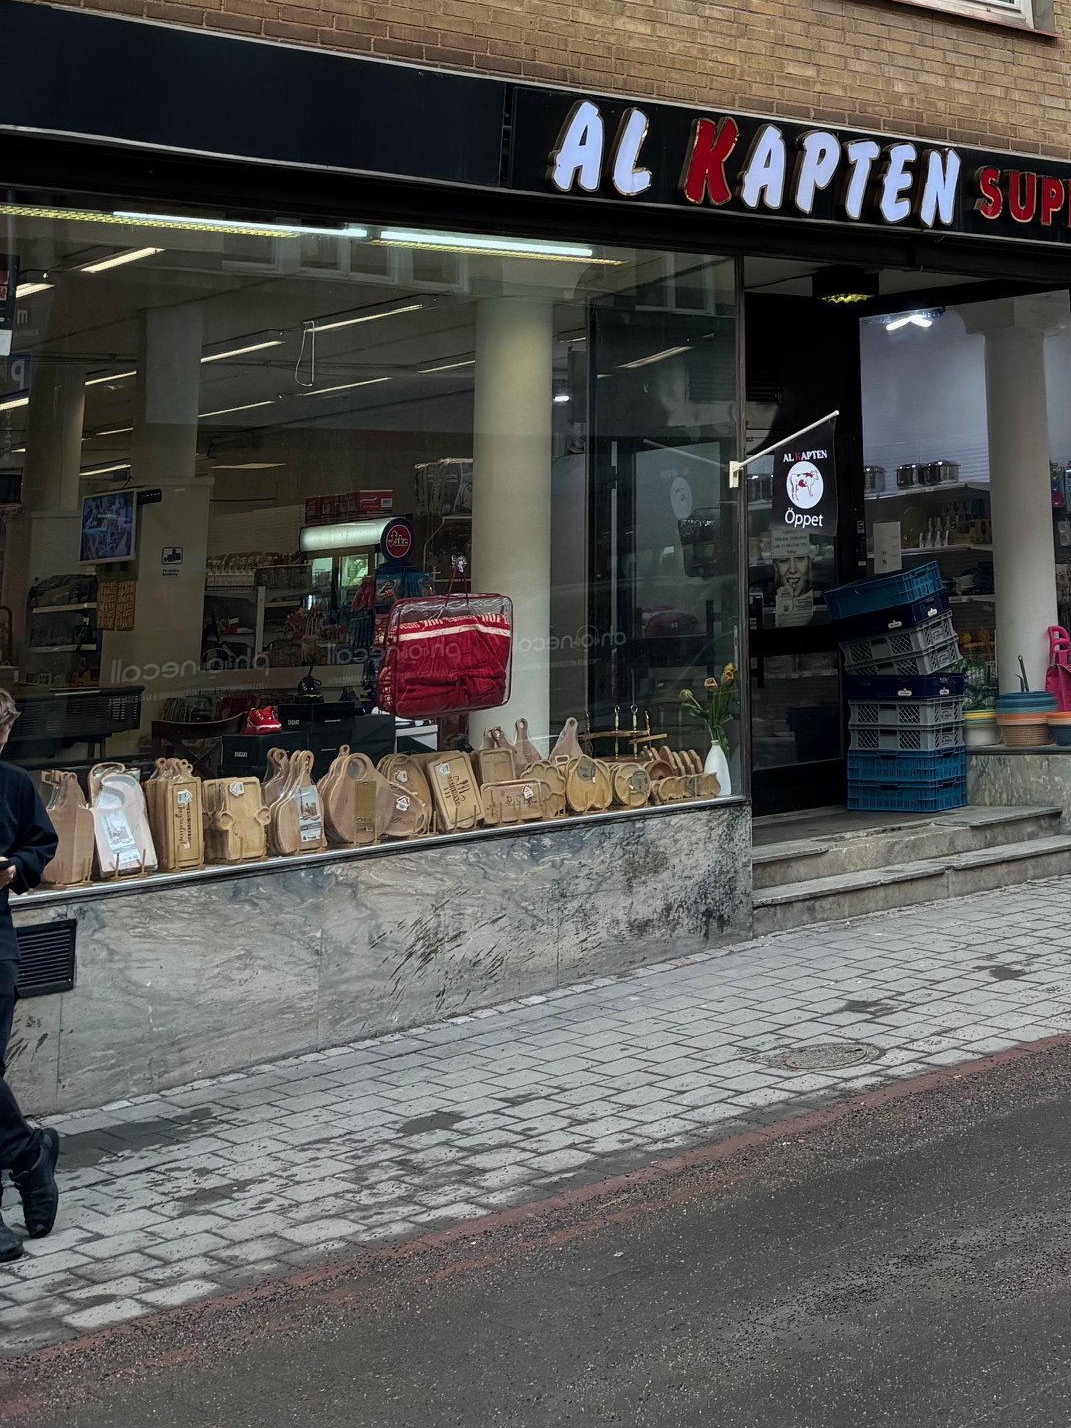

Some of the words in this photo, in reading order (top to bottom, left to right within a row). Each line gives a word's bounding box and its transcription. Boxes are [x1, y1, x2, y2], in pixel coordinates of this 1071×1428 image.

[550, 100, 652, 197] AL
[686, 116, 962, 228] KAPTEN
[794, 450, 828, 461] KAPTEN
[784, 507, 824, 528] Öppet
